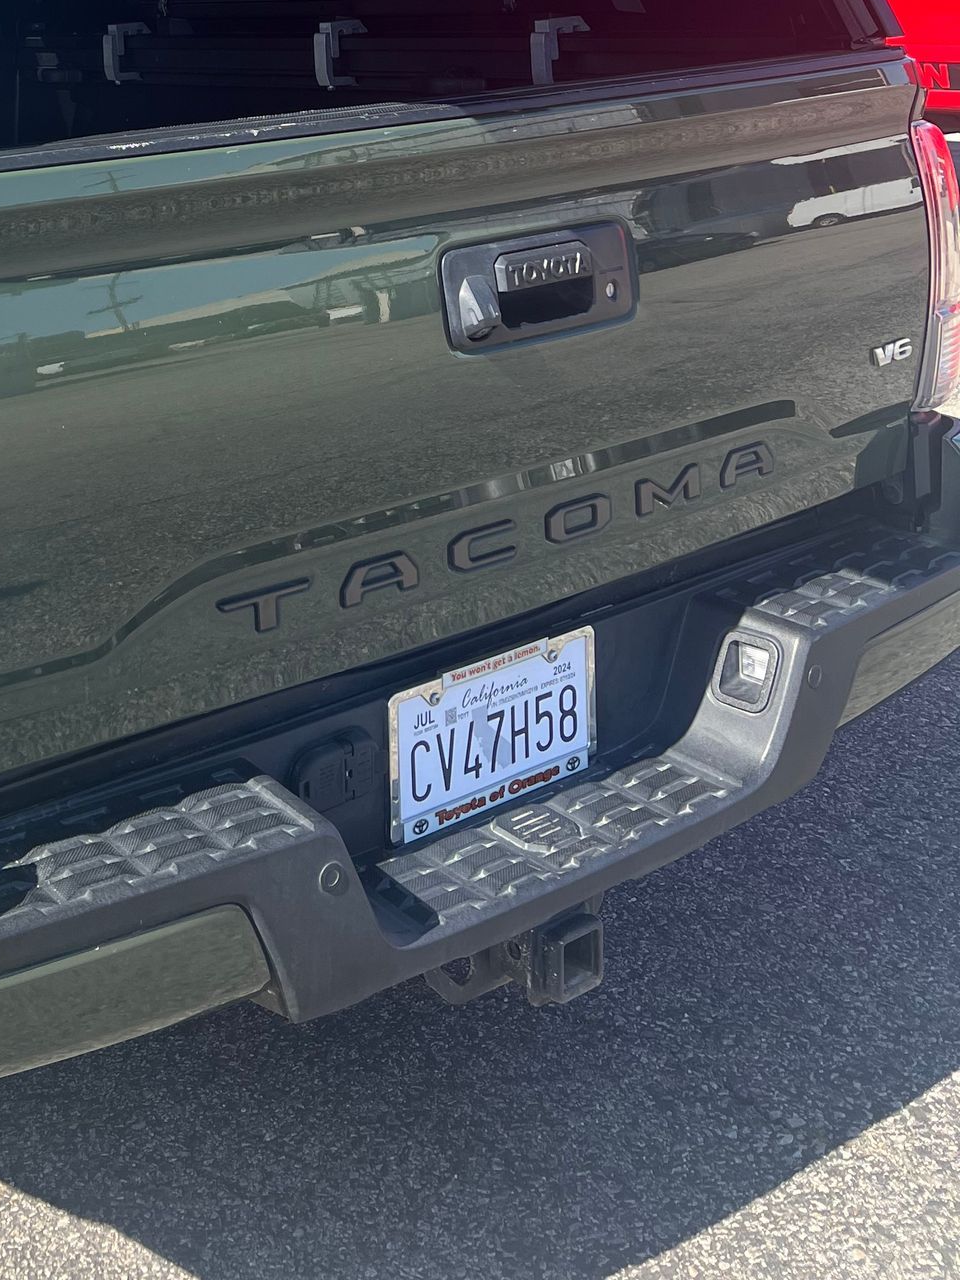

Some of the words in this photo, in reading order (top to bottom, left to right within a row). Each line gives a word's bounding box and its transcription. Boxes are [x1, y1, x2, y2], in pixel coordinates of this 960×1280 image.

[508, 252, 590, 287] TOYOTA
[872, 337, 914, 367] V6
[215, 440, 776, 633] TACOMA
[451, 671, 467, 682] You
[468, 663, 491, 677] won't
[492, 656, 506, 671] get
[461, 675, 528, 709] California
[553, 662, 572, 676] 2024
[413, 709, 436, 730] JUL
[410, 684, 578, 802] CV47H58
[435, 796, 486, 825] Toyota
[489, 785, 505, 802] of
[507, 765, 560, 795] Orange
